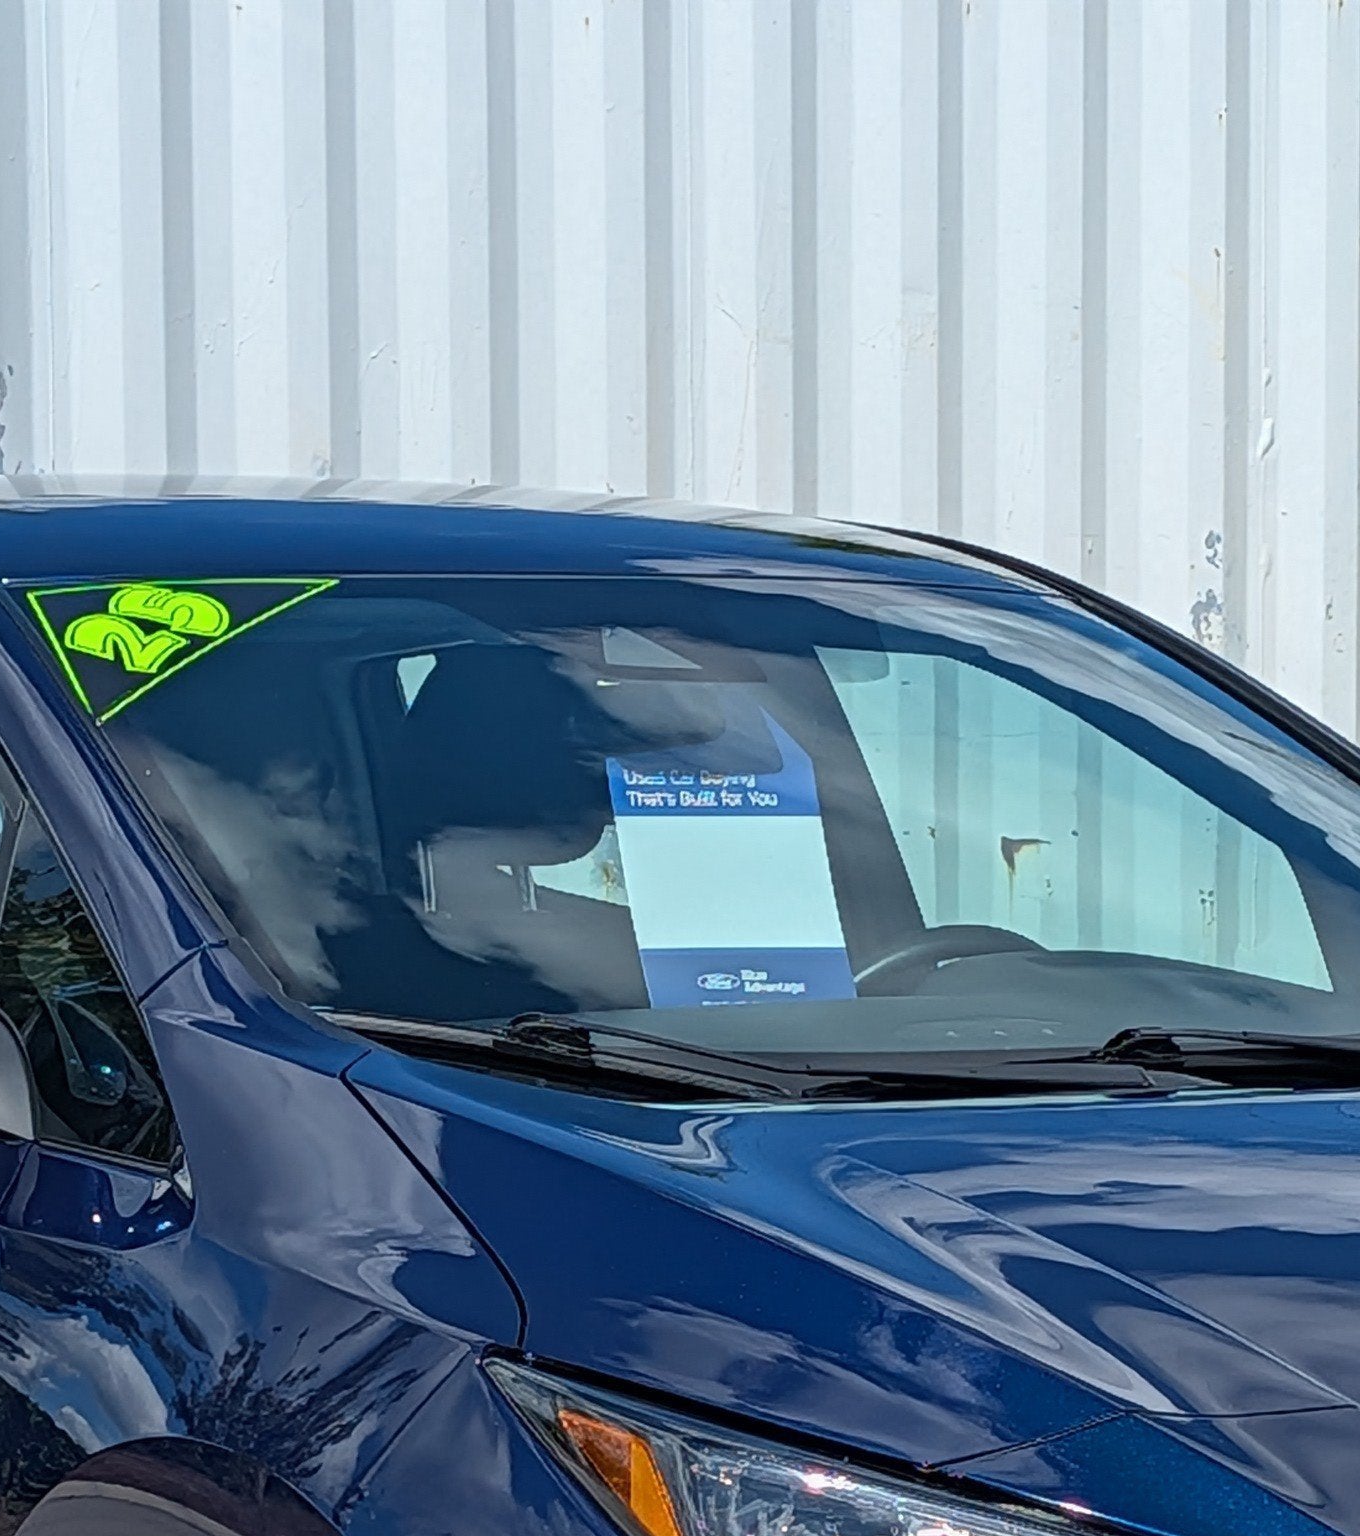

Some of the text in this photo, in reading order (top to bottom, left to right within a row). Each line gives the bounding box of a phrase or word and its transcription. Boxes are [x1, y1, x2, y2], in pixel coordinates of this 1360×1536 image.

[64, 584, 231, 674] 25
[720, 790, 743, 807] for
[747, 791, 778, 807] You
